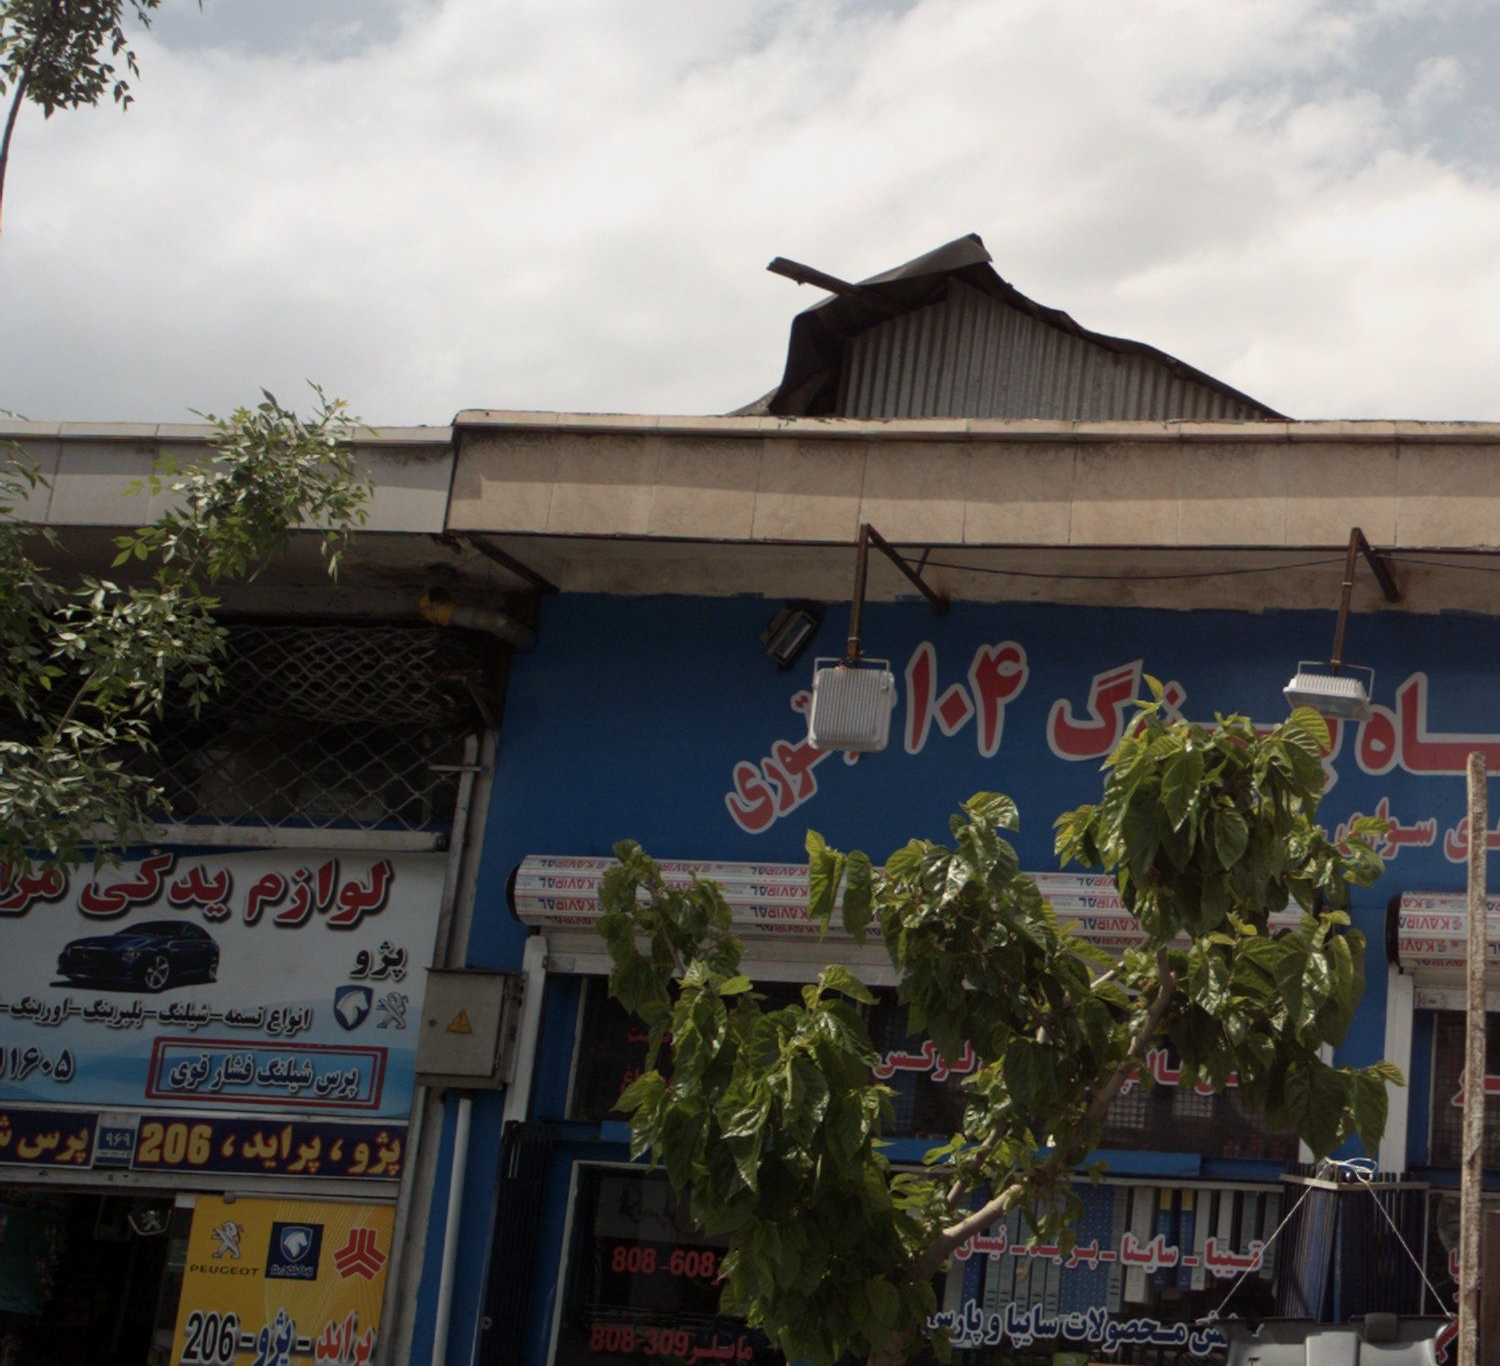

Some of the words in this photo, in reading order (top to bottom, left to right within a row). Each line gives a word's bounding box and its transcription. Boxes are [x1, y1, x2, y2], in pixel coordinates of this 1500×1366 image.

[904, 640, 1030, 758] ۱۰۴
[80, 852, 234, 917] یدکی
[245, 856, 395, 925] لوازم
[350, 940, 408, 979] پژو
[158, 1001, 211, 1030] شیلنگ
[223, 1007, 264, 1028] تسمه
[264, 1005, 312, 1034] انواع
[168, 1056, 210, 1090] قوی
[211, 1052, 254, 1089] فشار
[257, 1056, 313, 1090] شیلنگ
[317, 1059, 360, 1097] پرس
[16, 1123, 90, 1163] پرس
[138, 1121, 214, 1166] 206
[241, 1119, 322, 1172] پراید
[346, 1130, 402, 1175] پژو
[190, 1264, 259, 1276] PEUGEOT
[1062, 1307, 1188, 1352] محصولات
